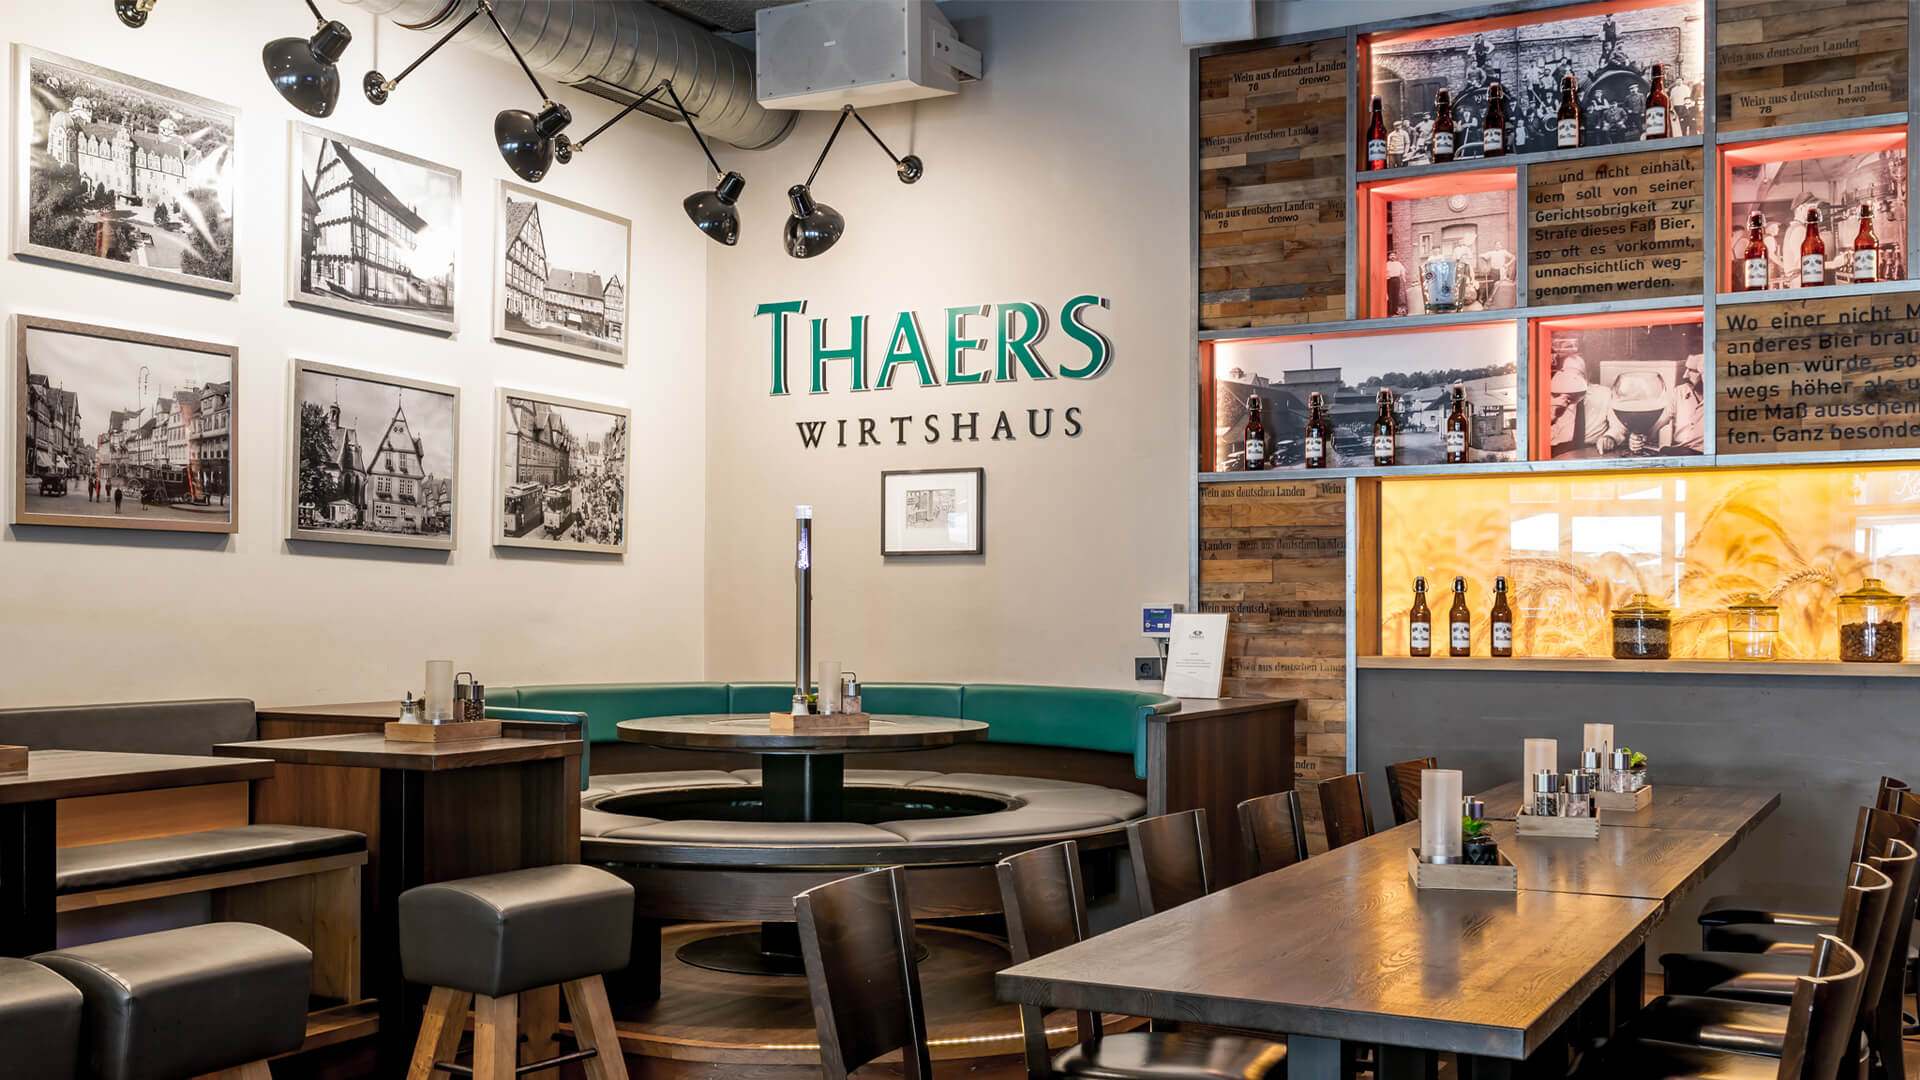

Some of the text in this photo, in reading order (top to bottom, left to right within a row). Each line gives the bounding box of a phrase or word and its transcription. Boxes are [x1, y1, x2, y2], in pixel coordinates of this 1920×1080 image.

[1767, 44, 1819, 58] deutschen
[1233, 61, 1346, 83] Wein aus deutschen Landen
[1740, 95, 1765, 108] Wein
[1768, 94, 1787, 105] aus
[1790, 87, 1843, 103] deutschen
[1847, 81, 1888, 96] Landen
[1245, 129, 1286, 142] deutschen
[1559, 170, 1584, 183] und
[1595, 165, 1629, 180] nicht
[1640, 159, 1695, 175] einhält,
[1535, 179, 1695, 204] dem soll von seiner
[1204, 200, 1314, 220] Wein aus deutschen Landen
[1535, 200, 1695, 223] Gerichtsobrigkeit zur
[1535, 217, 1695, 241] Strafe dieses Faß Bier,
[1535, 236, 1695, 260] so oft es vorkommt,
[1535, 258, 1688, 278] unnachsichtlich weg-
[1535, 277, 1675, 299] genommen werden.
[1727, 314, 1758, 332] Wo
[1771, 312, 1825, 329] einer
[1839, 305, 1891, 323] nicht
[754, 295, 1113, 395] THAERS
[1727, 331, 1919, 355] anderes Bier brau
[1728, 361, 1789, 377] haben
[1804, 355, 1879, 373] würde,
[1727, 376, 1920, 401] wegs höher als u
[1728, 399, 1920, 422] die Maß ausschen
[796, 407, 1084, 449] WIRTSHAUS
[1728, 421, 1920, 444] fen. Ganz besonde
[1200, 486, 1305, 498] Wein aus deutschen Landen
[1321, 483, 1342, 495] Wein
[1203, 540, 1232, 552] Landen
[1200, 602, 1219, 613] Wein
[1222, 603, 1235, 613] aus
[1277, 607, 1297, 618] Wein
[1275, 662, 1317, 673] deutschen
[1295, 760, 1316, 769] nden
